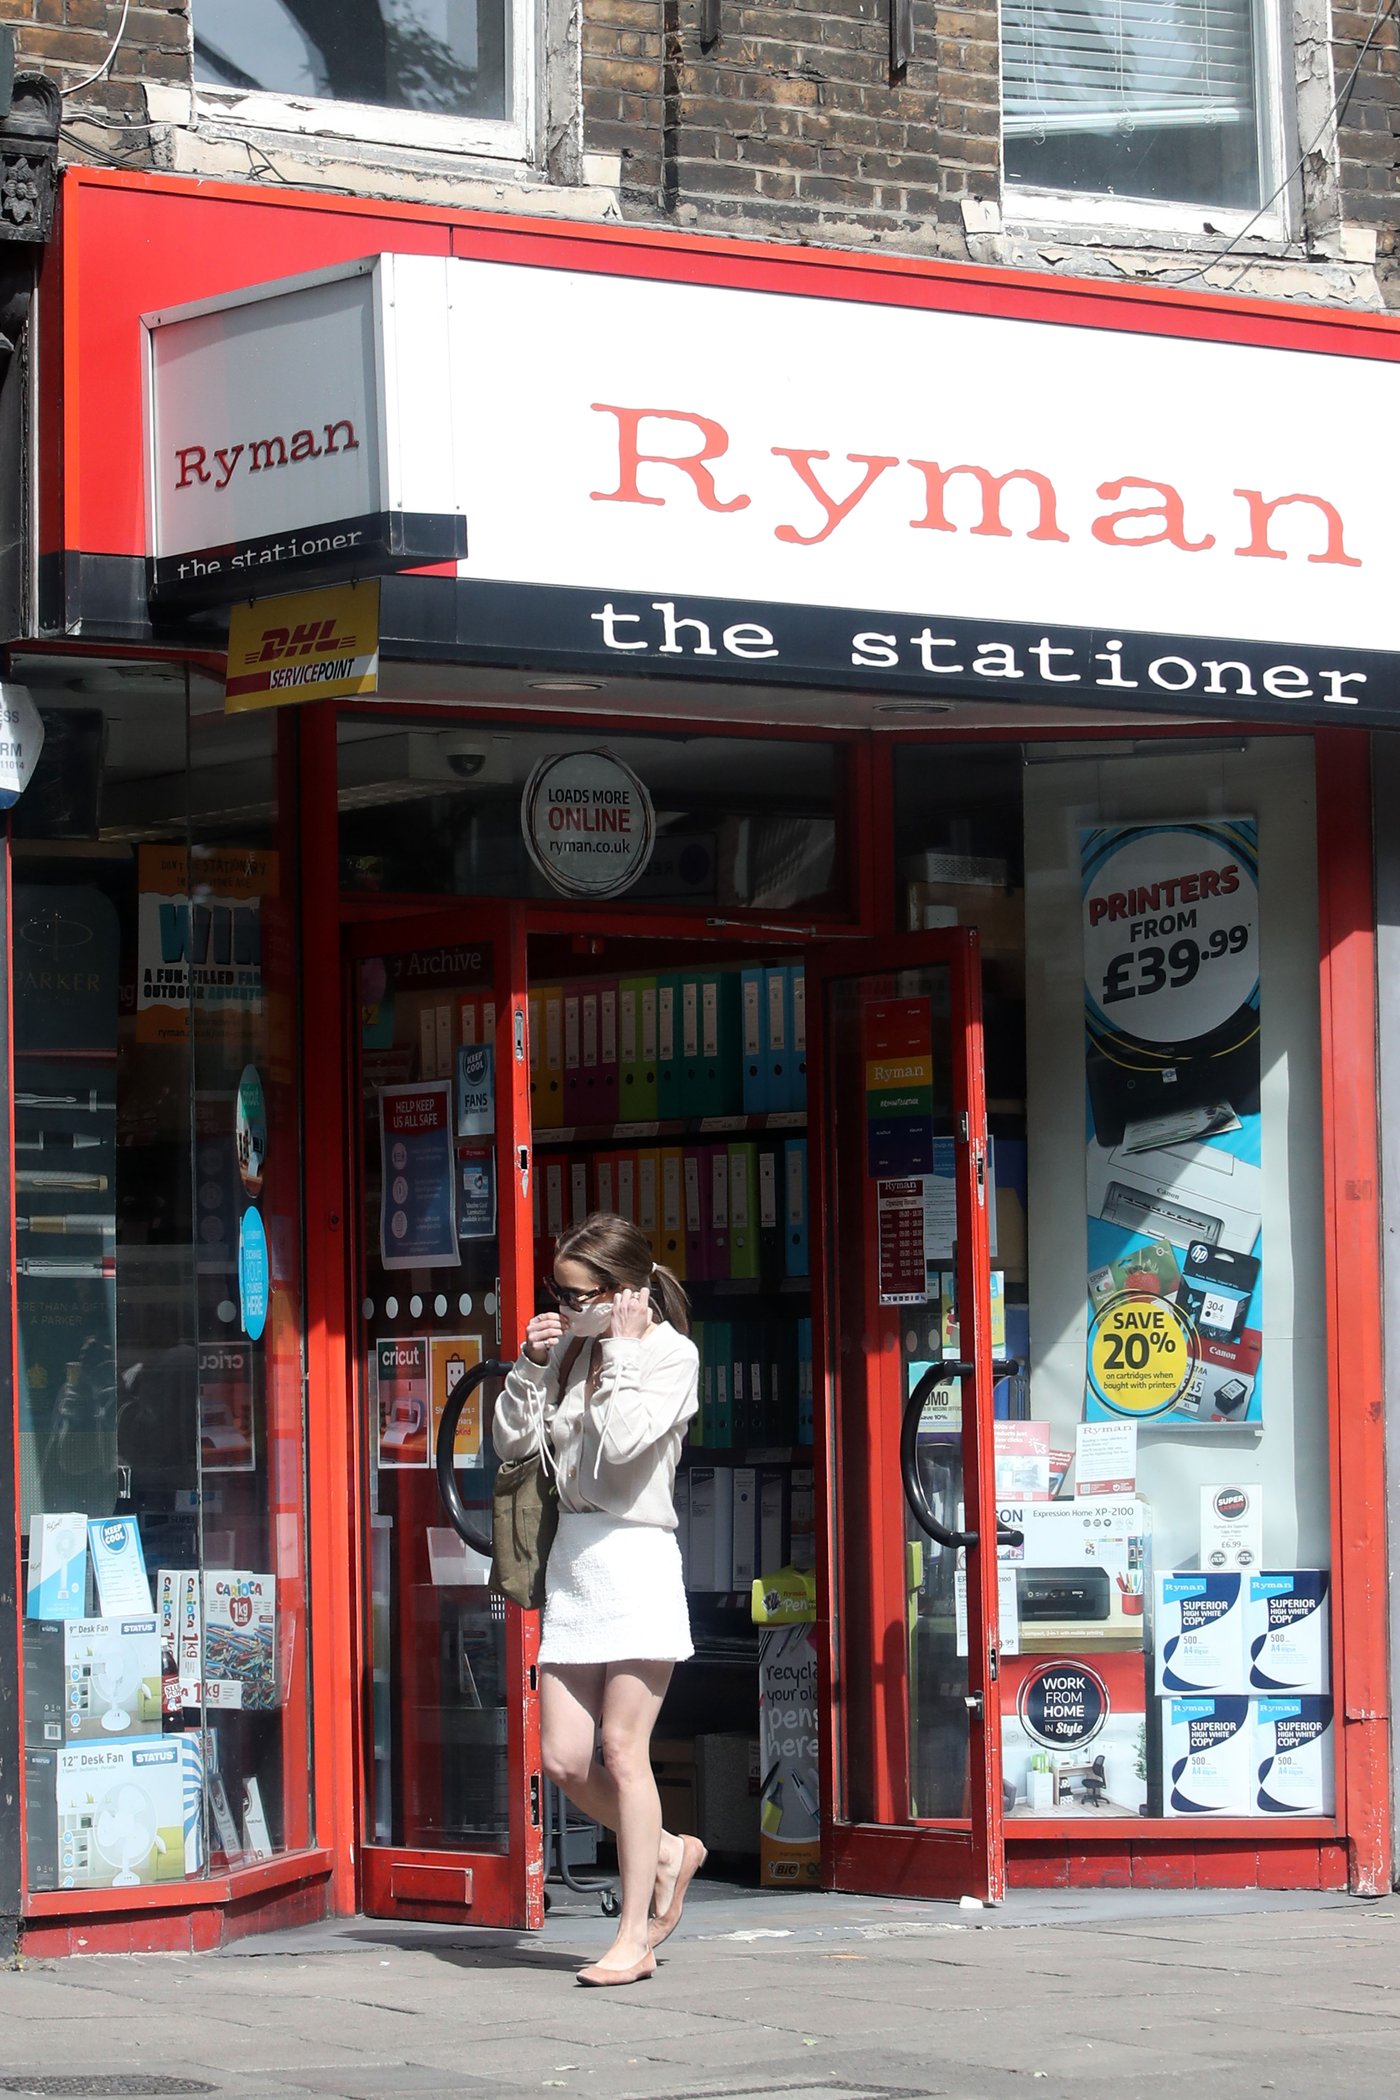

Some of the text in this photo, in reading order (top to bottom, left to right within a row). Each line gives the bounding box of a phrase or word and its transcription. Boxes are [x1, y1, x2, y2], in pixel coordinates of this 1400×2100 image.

[175, 418, 360, 490] Ryman
[590, 402, 1363, 569] Ryman
[177, 530, 363, 580] the stationer
[258, 619, 338, 663] DHL
[591, 601, 1368, 707] the stationer
[270, 657, 355, 690] SERVICEPOINT
[548, 788, 630, 805] LOADS MORE
[548, 806, 632, 833] ONLINE
[550, 838, 631, 856] ryman.co.uk
[1089, 864, 1241, 927] PRINTERS
[1130, 908, 1197, 944] FROM
[407, 949, 482, 976] Archive
[144, 968, 153, 983] A
[157, 969, 234, 985] FUN-FILLED
[144, 985, 204, 999] OUTDOOR
[466, 1061, 484, 1074] COOL
[874, 1065, 925, 1082] Ryman
[395, 1098, 435, 1113] HELP KEEP
[464, 1093, 488, 1108] FANS
[394, 1112, 438, 1129] US ALL SAFE
[885, 1181, 917, 1191] Ryman
[1156, 1186, 1180, 1200] Canon
[1206, 1300, 1224, 1313] 304
[1113, 1311, 1165, 1330] SAVE
[381, 1345, 420, 1367] cricut
[1103, 1332, 1176, 1370] 20%
[1209, 1346, 1237, 1361] Canon
[1116, 1371, 1152, 1381] cartridges
[1153, 1371, 1174, 1380] when
[1103, 1380, 1177, 1391] bought with printers
[1083, 1425, 1132, 1435] Ryman
[1218, 1495, 1245, 1507] SUPER
[1033, 1507, 1134, 1520] Expression Home XP-2100
[104, 1523, 123, 1536] KEEP
[105, 1532, 125, 1545] COOL
[1165, 1583, 1205, 1593] Ryman
[1252, 1581, 1292, 1591] Ryman
[784, 1598, 808, 1613] Pen
[1183, 1601, 1229, 1610] SUPERIOR
[1270, 1599, 1316, 1608] SUPERIOR
[1200, 1609, 1222, 1617] WHITE
[1288, 1607, 1309, 1615] WHITE
[1183, 1616, 1206, 1625] COPY
[1270, 1615, 1293, 1624] COPY
[79, 1624, 95, 1634] Desk
[96, 1624, 108, 1632] Fan
[123, 1624, 154, 1633] STATUS
[1183, 1635, 1198, 1645] 500
[1271, 1634, 1285, 1643] 500
[1042, 1677, 1086, 1690] WORK
[766, 1686, 797, 1707] your
[1045, 1691, 1083, 1704] FROM
[1043, 1705, 1085, 1718] HOME
[1173, 1704, 1213, 1713] Ryman
[1260, 1704, 1299, 1713] Ryman
[1045, 1722, 1084, 1736] IN Style
[1191, 1722, 1237, 1731] SUPERIOR
[1278, 1722, 1323, 1731] SUPERIOR
[1208, 1730, 1230, 1738] WHITE
[1295, 1730, 1317, 1738] WHITE
[767, 1732, 819, 1759] here
[1191, 1738, 1214, 1747] COPY
[1277, 1738, 1301, 1747] COPY
[81, 1753, 105, 1766] Desk
[106, 1752, 124, 1763] Fan
[135, 1750, 176, 1763] STATUS
[1192, 1757, 1206, 1765] 500
[1278, 1757, 1292, 1765] 500
[776, 1865, 798, 1877] BIC
